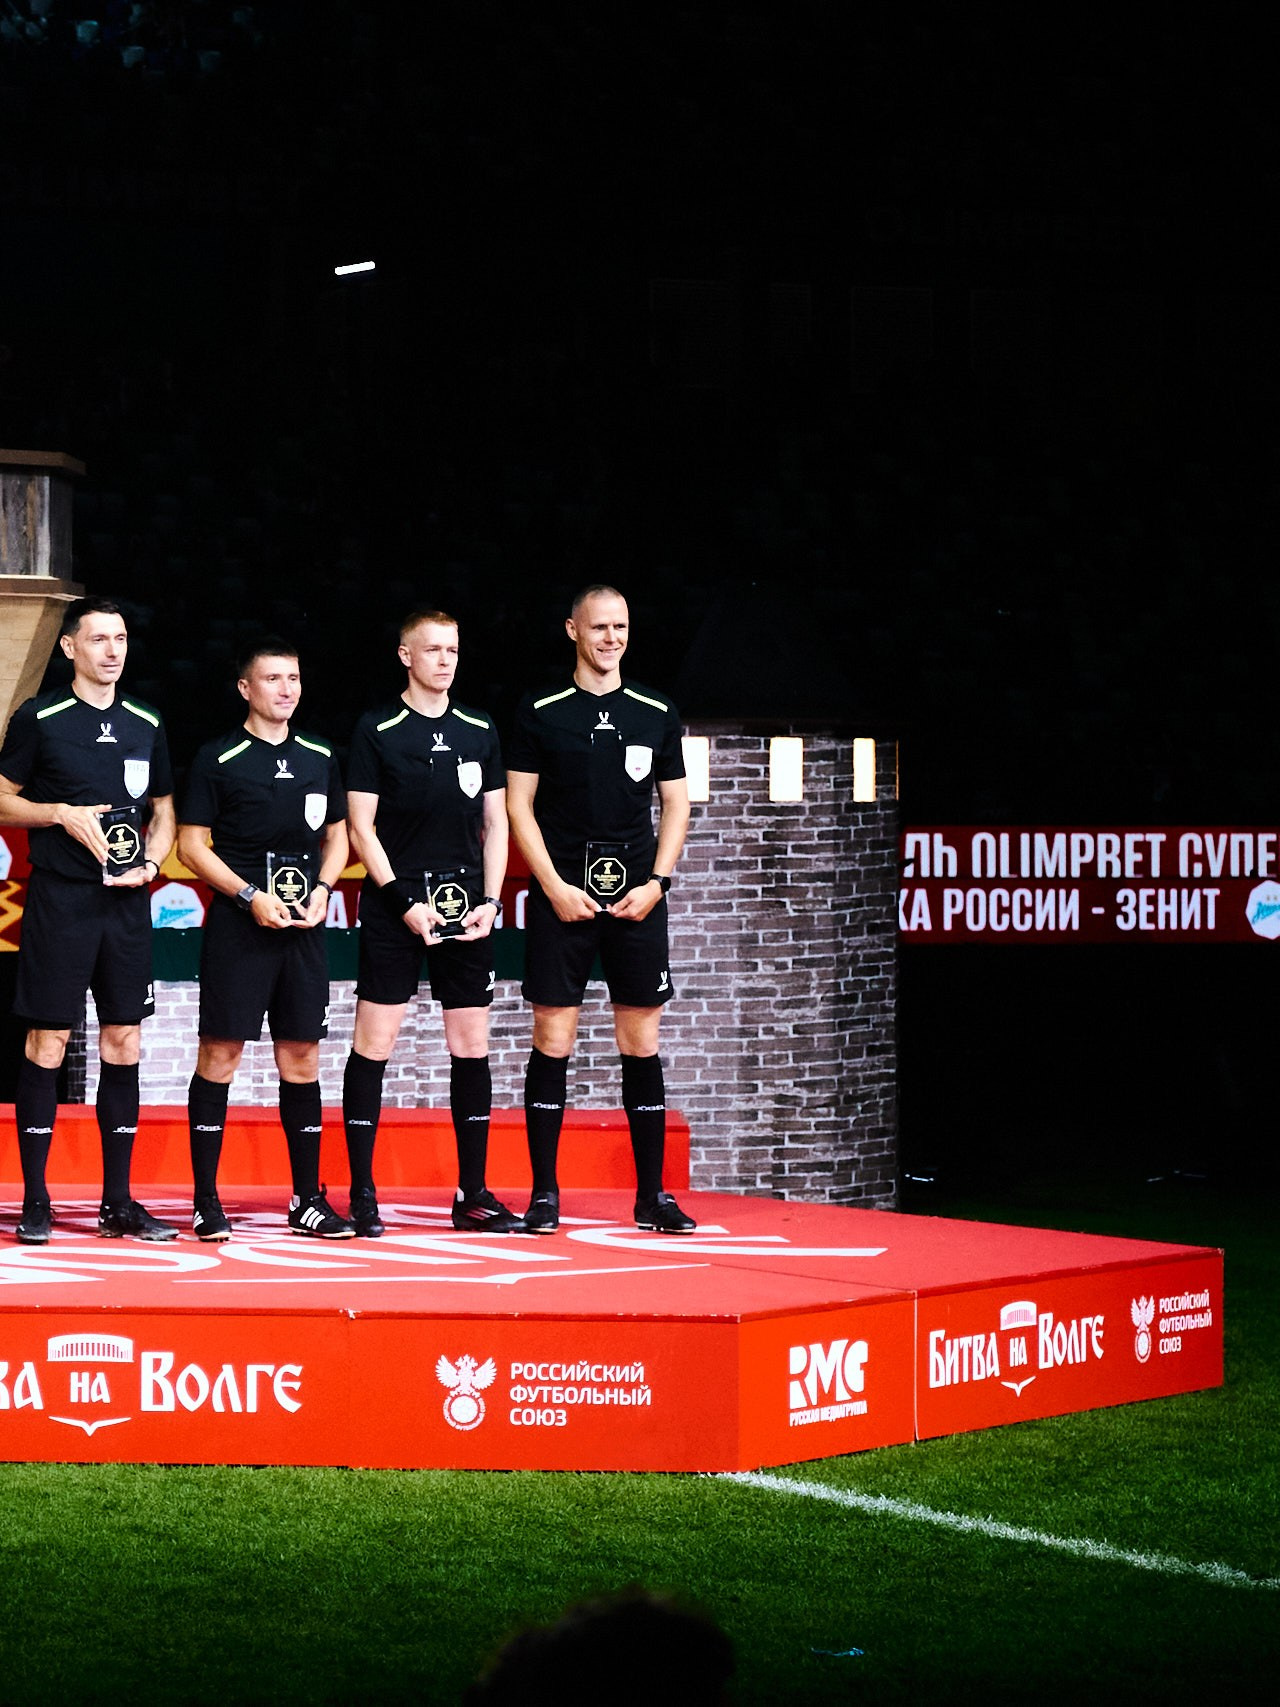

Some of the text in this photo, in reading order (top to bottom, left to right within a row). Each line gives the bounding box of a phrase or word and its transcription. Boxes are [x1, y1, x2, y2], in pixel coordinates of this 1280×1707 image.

[971, 832, 1167, 878] OLIMPBET
[943, 888, 1080, 931] РОССИИ
[1116, 888, 1220, 931] ЗЕНИТ
[1159, 1289, 1210, 1313] РОССИЙСКИЙ
[1159, 1308, 1213, 1334] ФУТБОЛЬНЫЙ
[1159, 1336, 1182, 1354] СОЮЗ
[510, 1360, 645, 1383] РОССИЙСКИЙ
[789, 1339, 869, 1410] RMG
[509, 1384, 652, 1406] ФУТБОЛЬНЫЙ
[509, 1407, 567, 1427] СОЮЗ
